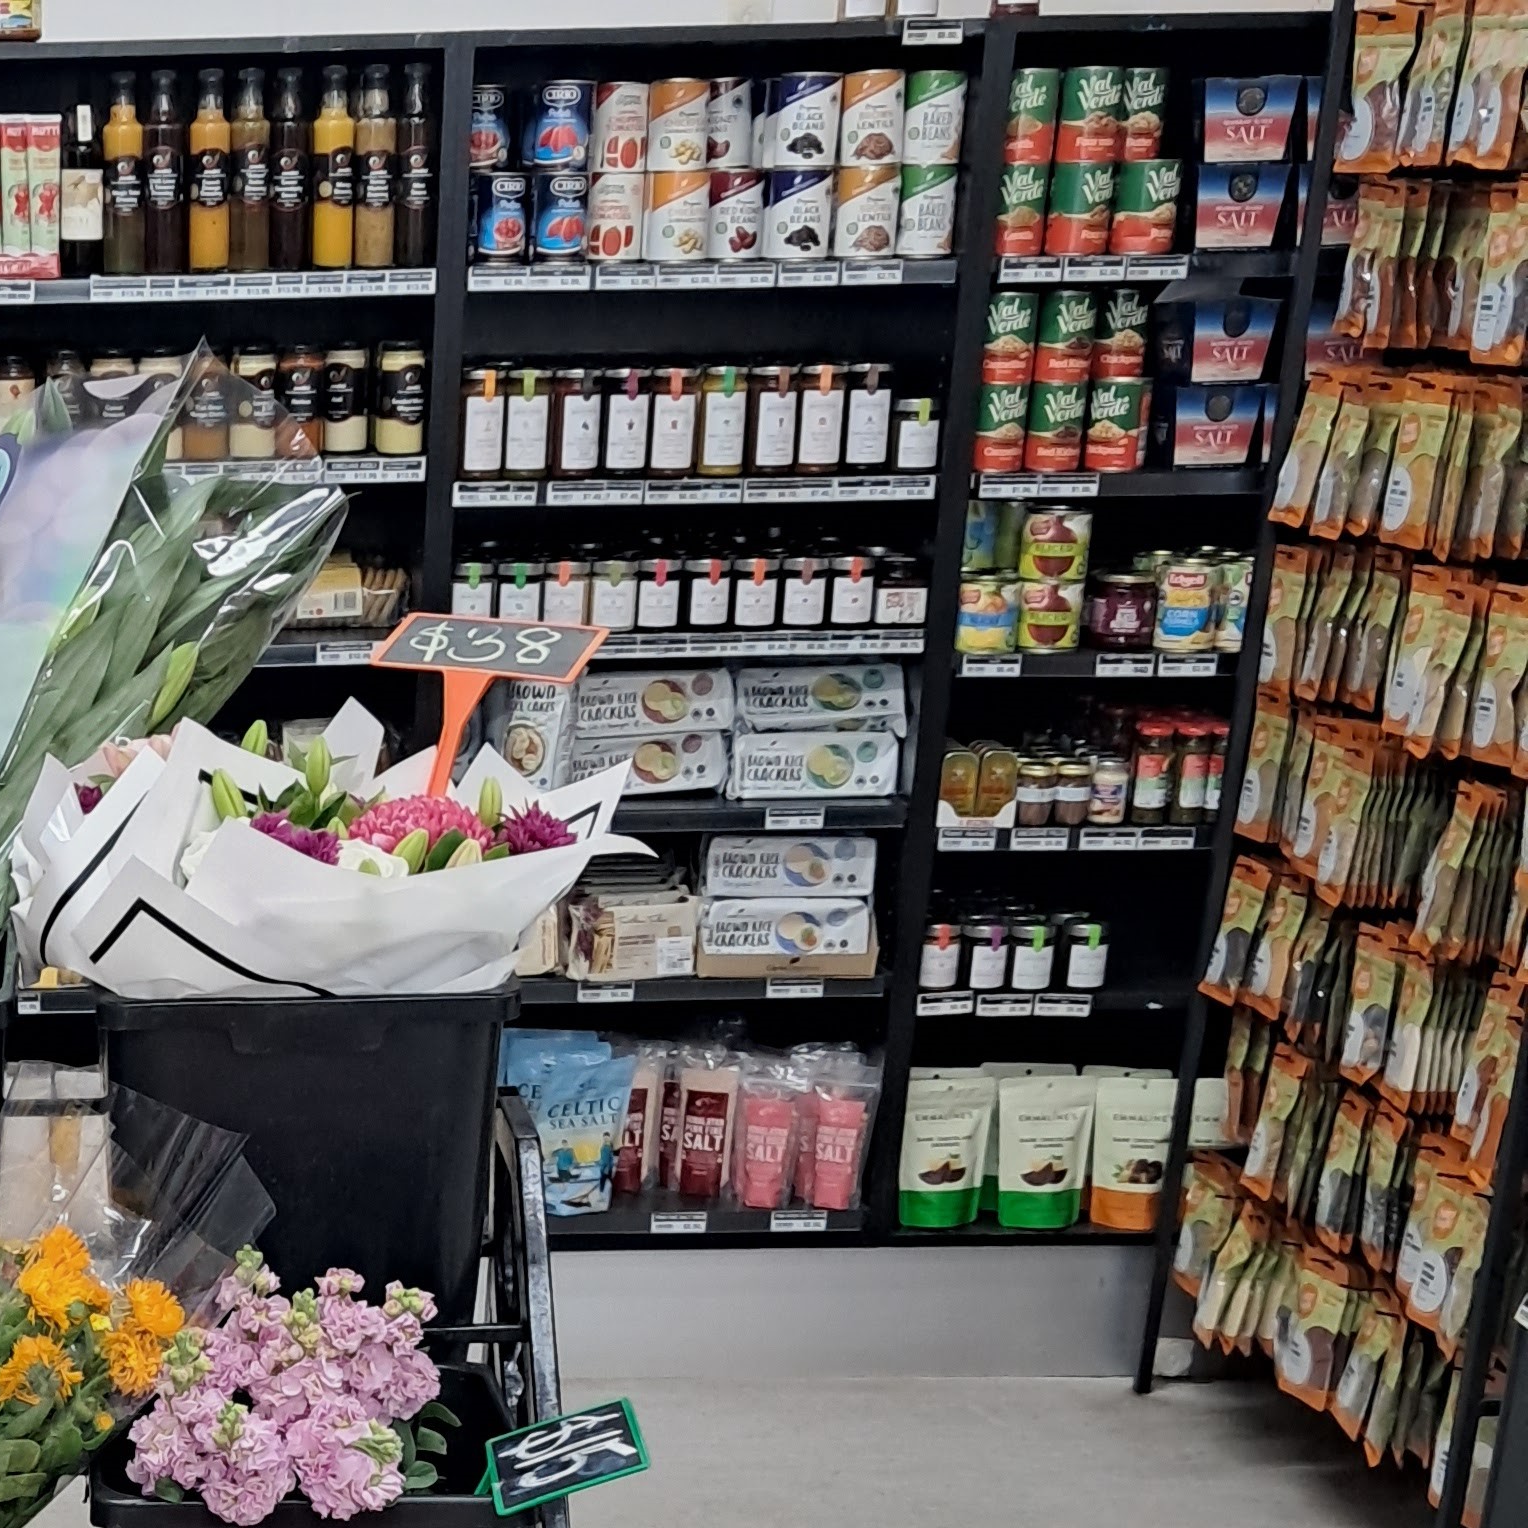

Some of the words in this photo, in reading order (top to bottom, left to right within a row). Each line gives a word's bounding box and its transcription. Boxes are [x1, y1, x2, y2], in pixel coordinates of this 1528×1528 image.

[1079, 72, 1113, 96] Val
[1125, 73, 1150, 96] Val
[1077, 85, 1122, 110] Verde
[1225, 126, 1269, 145] SALT
[1002, 167, 1034, 192] Val
[1217, 213, 1258, 230] SALT
[989, 298, 1020, 322] Val
[1059, 298, 1090, 321] Val
[1108, 294, 1140, 318] Val
[1212, 346, 1248, 363] SALT
[989, 386, 1021, 410] Val
[1047, 386, 1078, 410] Val
[1092, 386, 1116, 408] Val
[1194, 430, 1233, 448] SALT
[409, 620, 563, 665] $38
[580, 704, 637, 722] CRACKERS
[747, 767, 802, 781] CRACKERS
[722, 852, 756, 865] BROWN
[722, 865, 778, 879] CRACKERS
[716, 921, 749, 933] BROWN
[714, 933, 770, 947] CRACKERS
[547, 1095, 621, 1119] CELTIC
[549, 1118, 576, 1130] SEA
[581, 1113, 618, 1127] SALT
[683, 1133, 723, 1152] SALT
[746, 1144, 784, 1162] SALT
[815, 1143, 853, 1163] SALT
